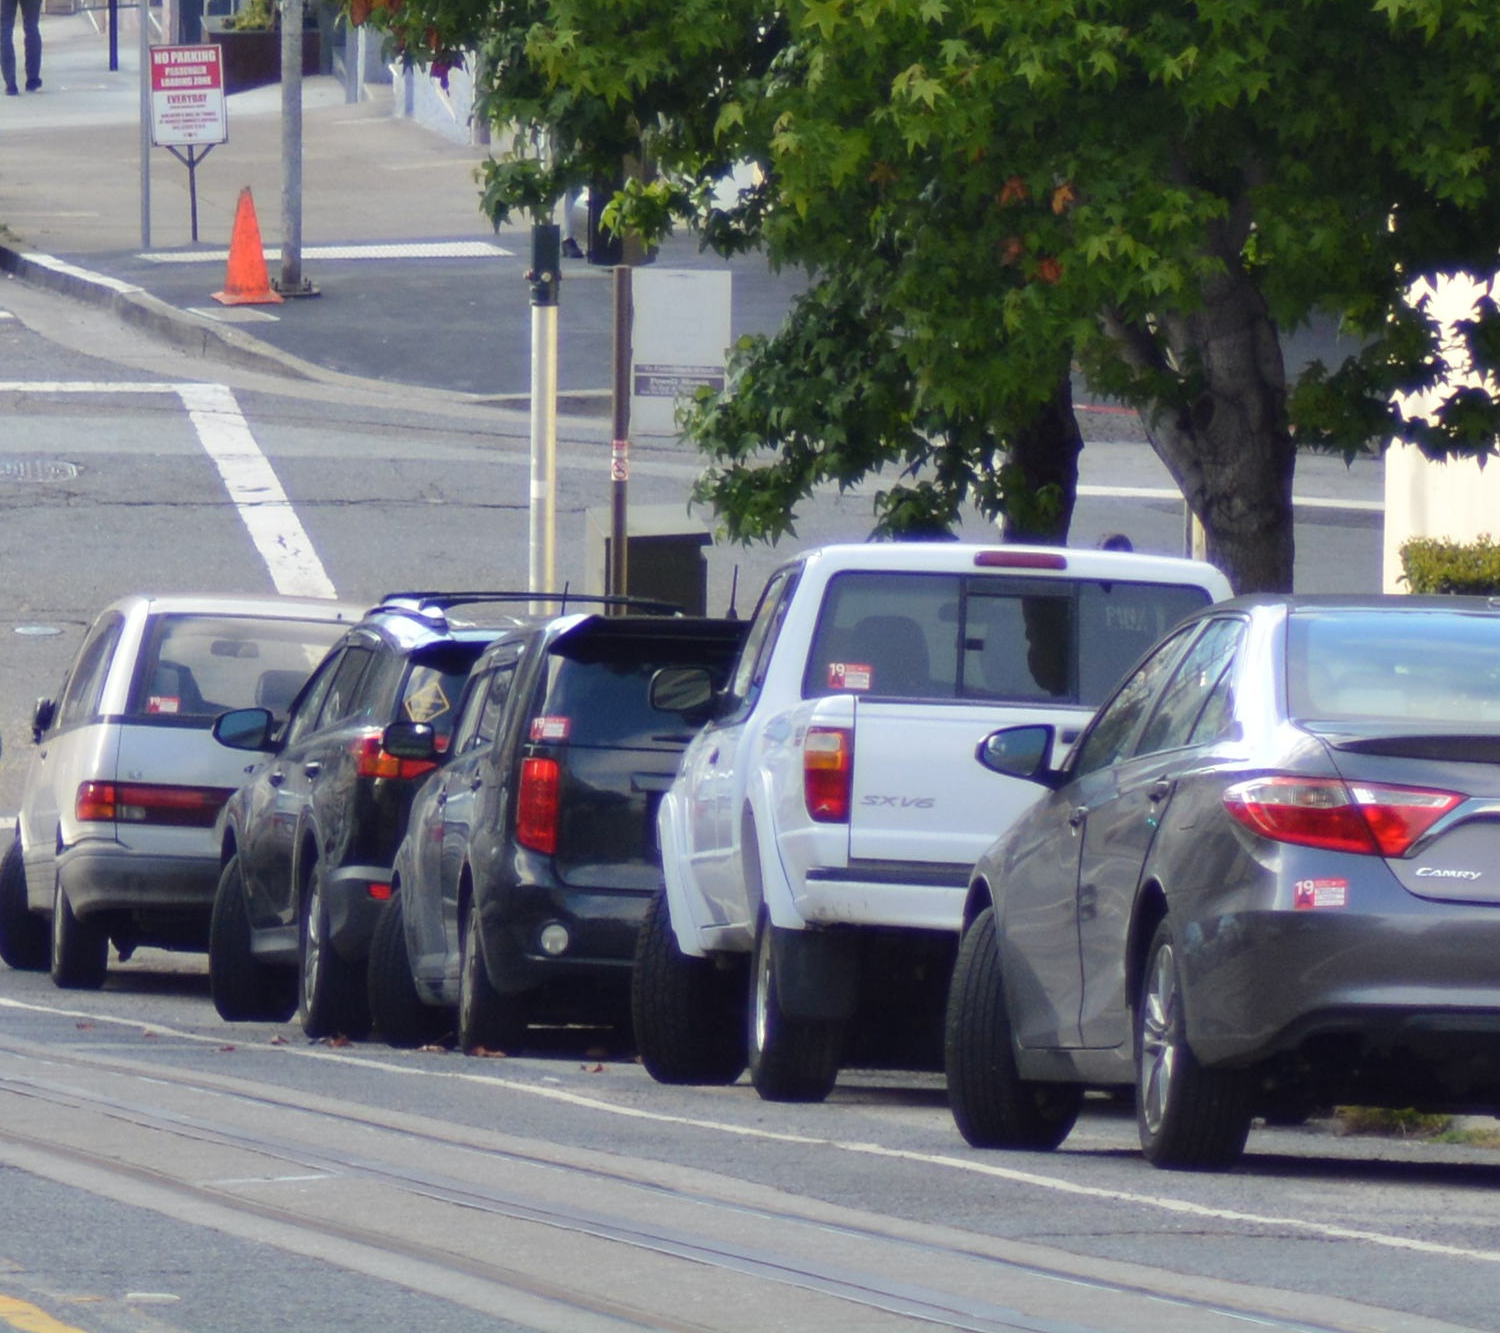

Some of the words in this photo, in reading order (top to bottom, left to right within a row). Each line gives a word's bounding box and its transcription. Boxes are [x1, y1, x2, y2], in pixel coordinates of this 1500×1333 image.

[153, 51, 169, 64] NO
[170, 49, 217, 64] PARKING
[167, 93, 207, 104] EVERYDAY
[829, 663, 845, 676] 19
[1415, 867, 1483, 881] CAMRY
[1295, 879, 1315, 896] 19
